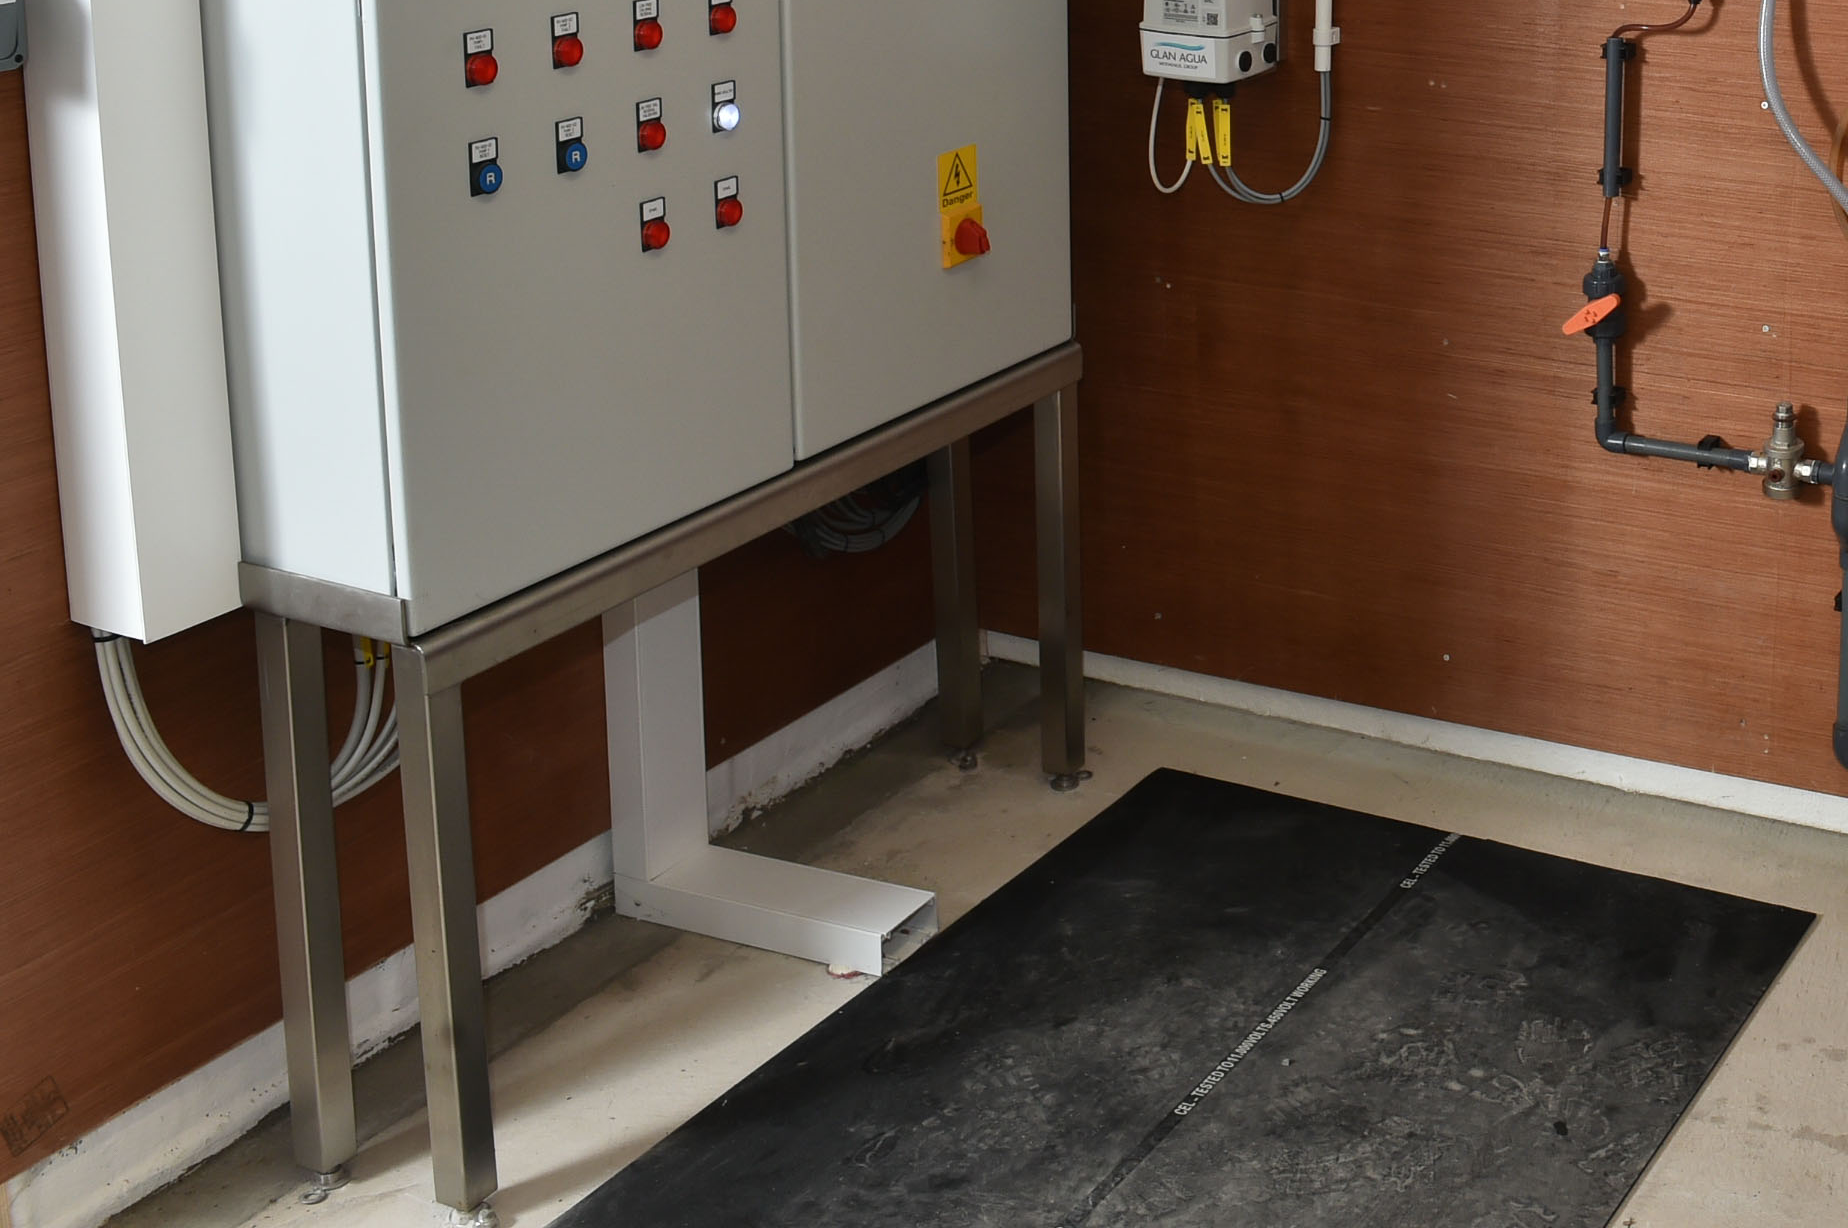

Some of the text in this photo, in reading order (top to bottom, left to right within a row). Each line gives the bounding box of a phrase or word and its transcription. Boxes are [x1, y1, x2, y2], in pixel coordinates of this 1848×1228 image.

[1150, 48, 1208, 65] GLAN AGUA
[571, 151, 581, 163] R
[486, 172, 496, 185] R
[942, 191, 973, 208] Danger
[1174, 1101, 1197, 1116] CEL
[1191, 1070, 1226, 1097] TESTED
[1216, 1061, 1235, 1075] TO
[1290, 968, 1328, 998] WORKING
